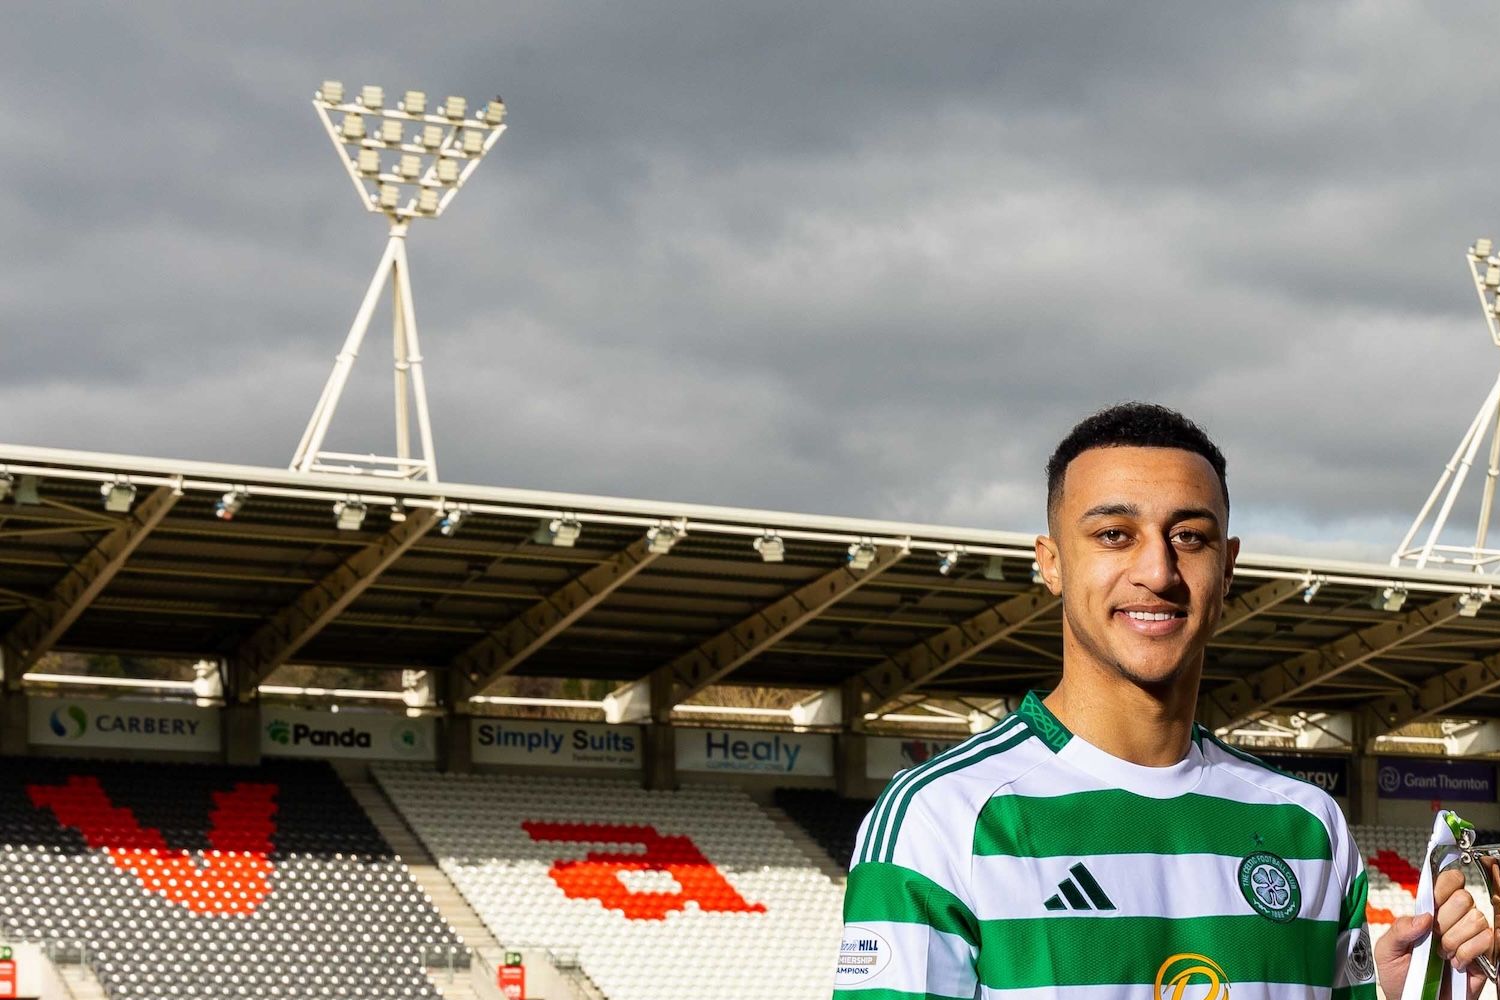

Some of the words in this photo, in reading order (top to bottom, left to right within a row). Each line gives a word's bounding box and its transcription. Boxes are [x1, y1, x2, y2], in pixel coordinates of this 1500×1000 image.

[96, 714, 199, 736] CARBERY
[293, 723, 371, 748] Panda
[478, 725, 563, 755] Simply
[572, 727, 635, 753] Suits
[706, 732, 800, 773] Healy
[1405, 775, 1436, 788] Grant
[1438, 776, 1489, 790] Thornton
[1256, 855, 1286, 873] FOOTBALL
[858, 939, 878, 951] HILL
